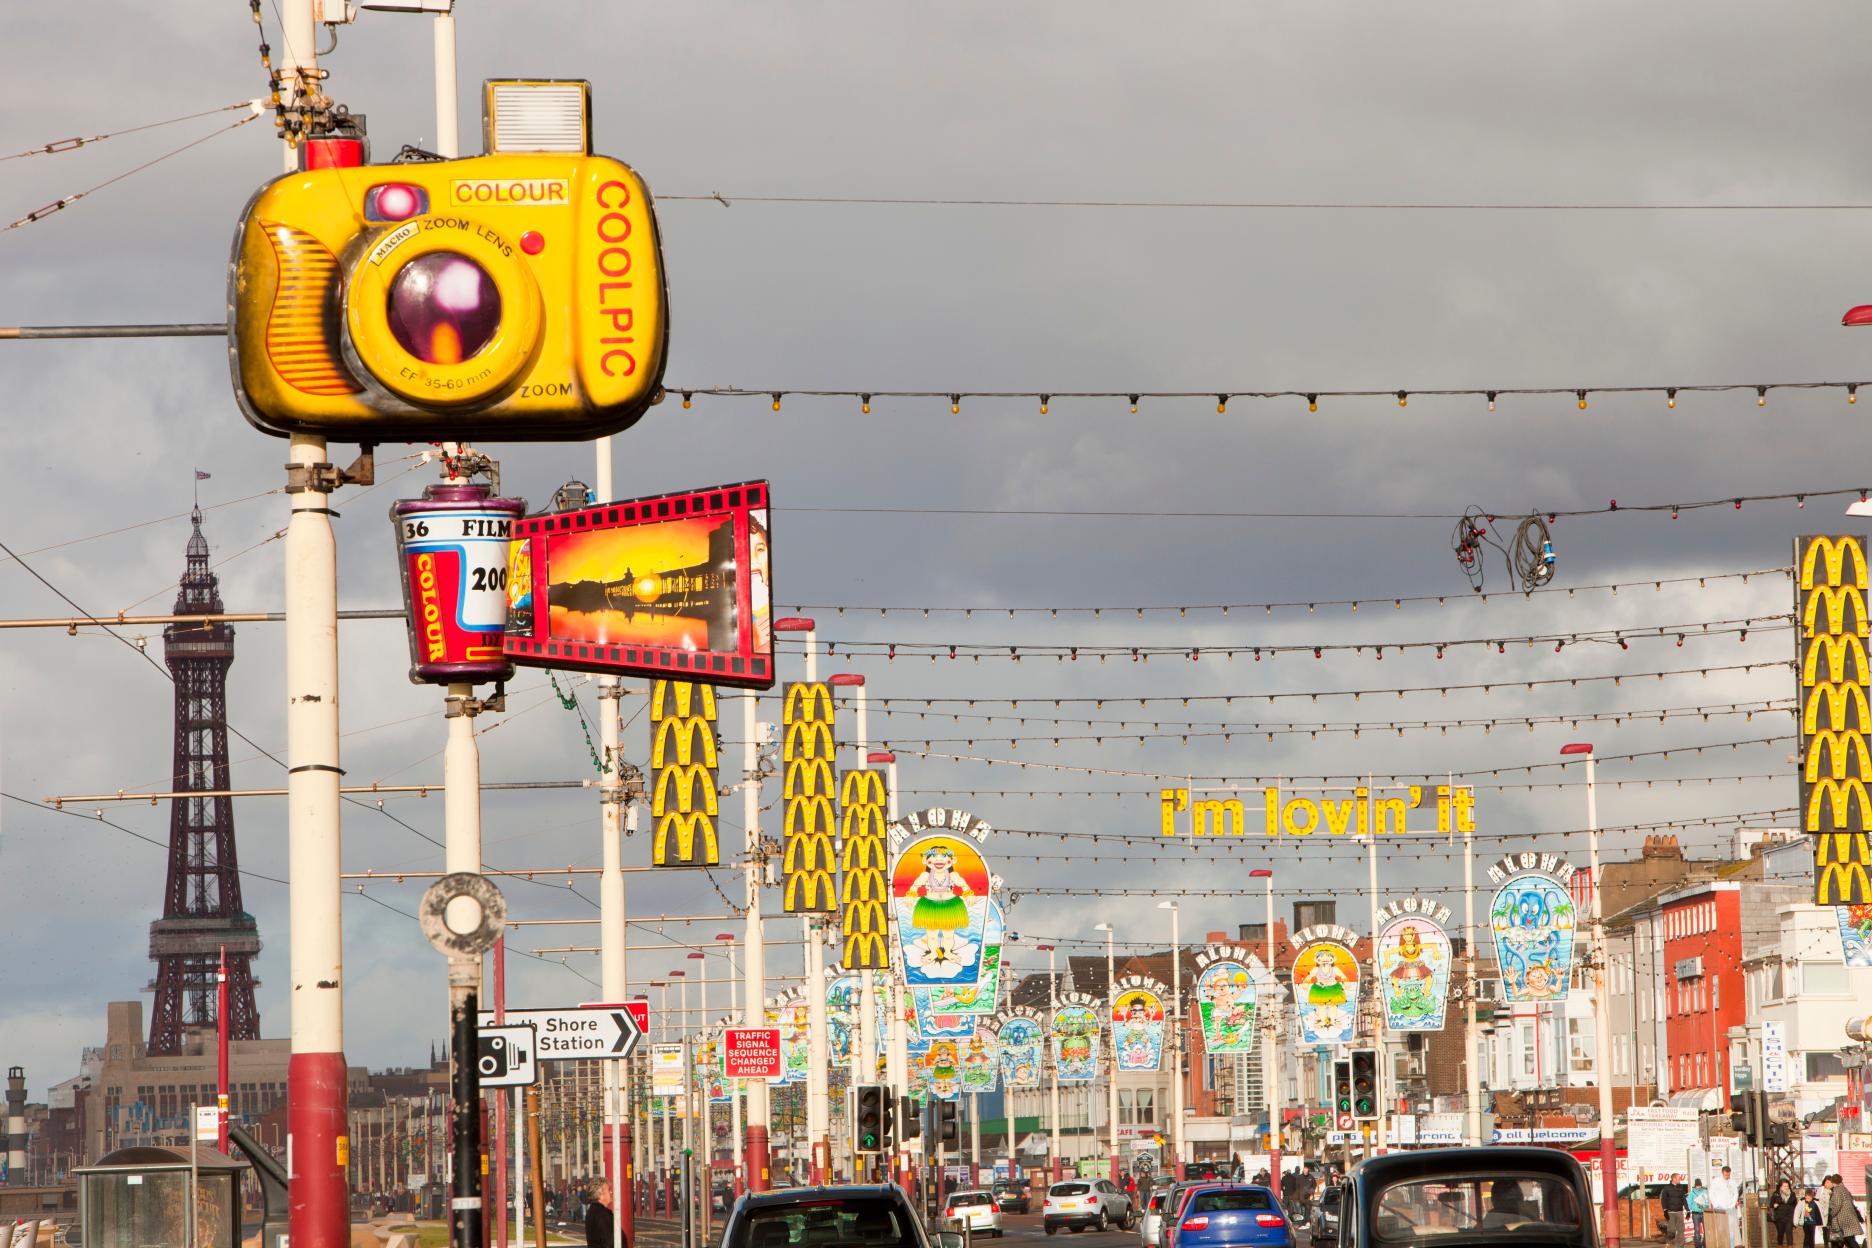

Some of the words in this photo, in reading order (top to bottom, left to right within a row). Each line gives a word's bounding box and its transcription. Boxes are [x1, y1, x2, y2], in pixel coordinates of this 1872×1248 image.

[456, 183, 564, 202] COLOUR
[376, 227, 411, 261] MACRO
[424, 218, 470, 231] ZOOM
[476, 225, 514, 258] LENS
[596, 180, 636, 378] COOLPIC
[400, 367, 419, 381] EF
[425, 374, 464, 390] 35-60
[466, 368, 493, 385] mm
[520, 382, 574, 398] ZOOM
[406, 521, 429, 538] 36
[462, 519, 511, 537] FILM
[472, 567, 508, 592] 200
[417, 553, 444, 663] COLOUR
[1161, 787, 1244, 836] i'm
[1266, 785, 1422, 836] lovin'
[1437, 785, 1476, 833] it
[888, 808, 991, 845] ALOHA
[1487, 852, 1576, 884] ALOHA
[1376, 897, 1452, 926] ALOHA
[1290, 924, 1359, 950] ALOHA
[1195, 947, 1259, 968] ALOHA
[546, 1018, 598, 1032] Shore
[634, 1014, 646, 1023] UT
[540, 1036, 604, 1050] Station
[734, 1031, 771, 1040] TRAFFIC
[728, 1049, 778, 1057] SEQUENCE
[730, 1057, 776, 1065] CHANGED
[738, 1066, 769, 1074] AHEAD
[1527, 1130, 1587, 1139] welcome
